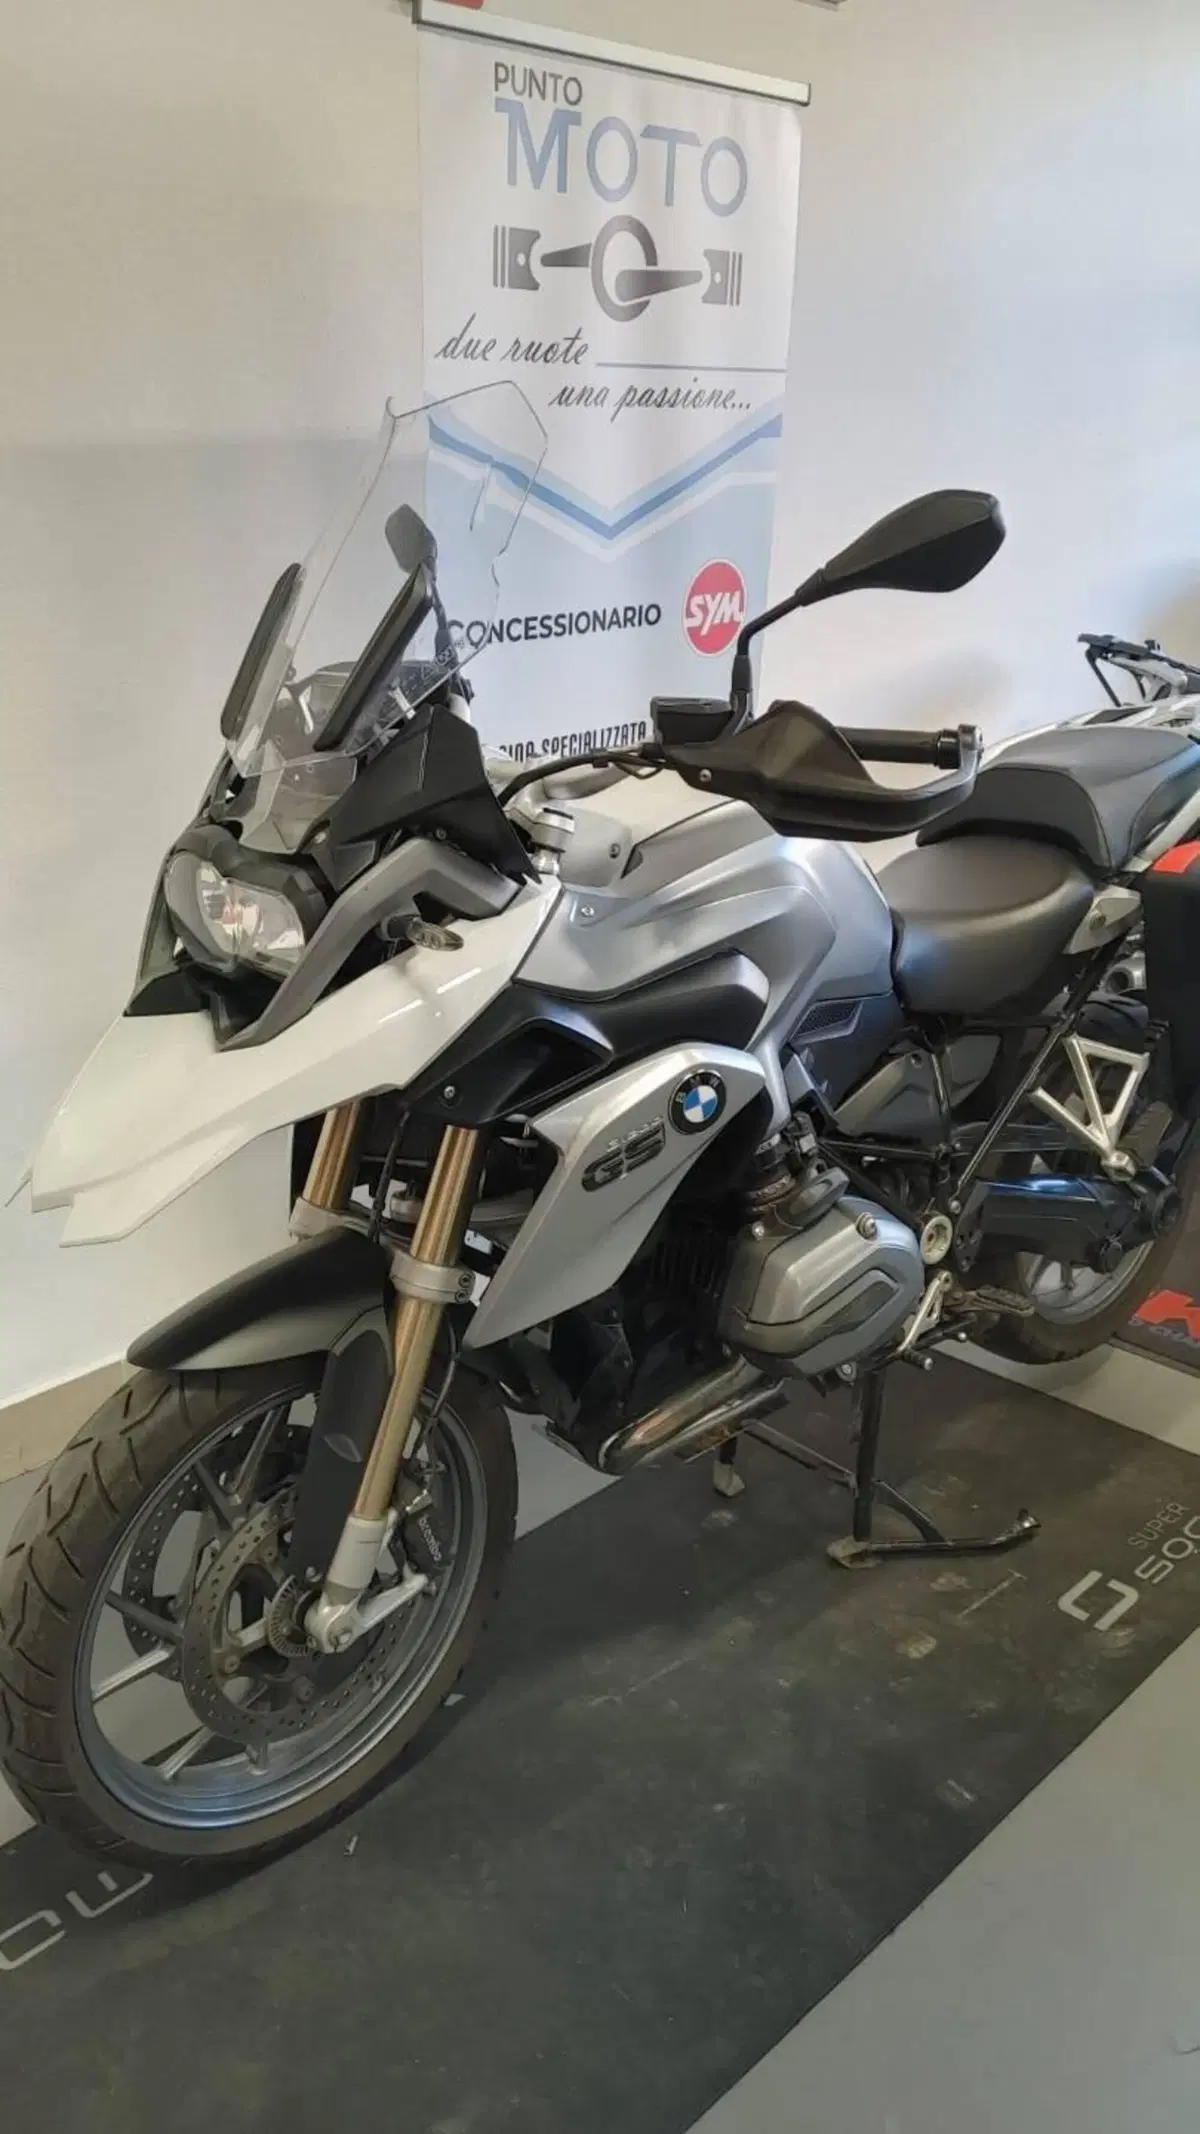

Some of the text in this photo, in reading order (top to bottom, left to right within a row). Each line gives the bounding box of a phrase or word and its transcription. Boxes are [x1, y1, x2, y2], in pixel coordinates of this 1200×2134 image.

[493, 61, 584, 106] PUNTO
[494, 96, 749, 218] MOTO
[434, 312, 590, 366] due ruote
[548, 375, 752, 423] una passione...
[684, 590, 745, 637] SYM
[540, 720, 648, 759] SPECIALIZZATA
[1127, 1501, 1192, 1550] SUPER
